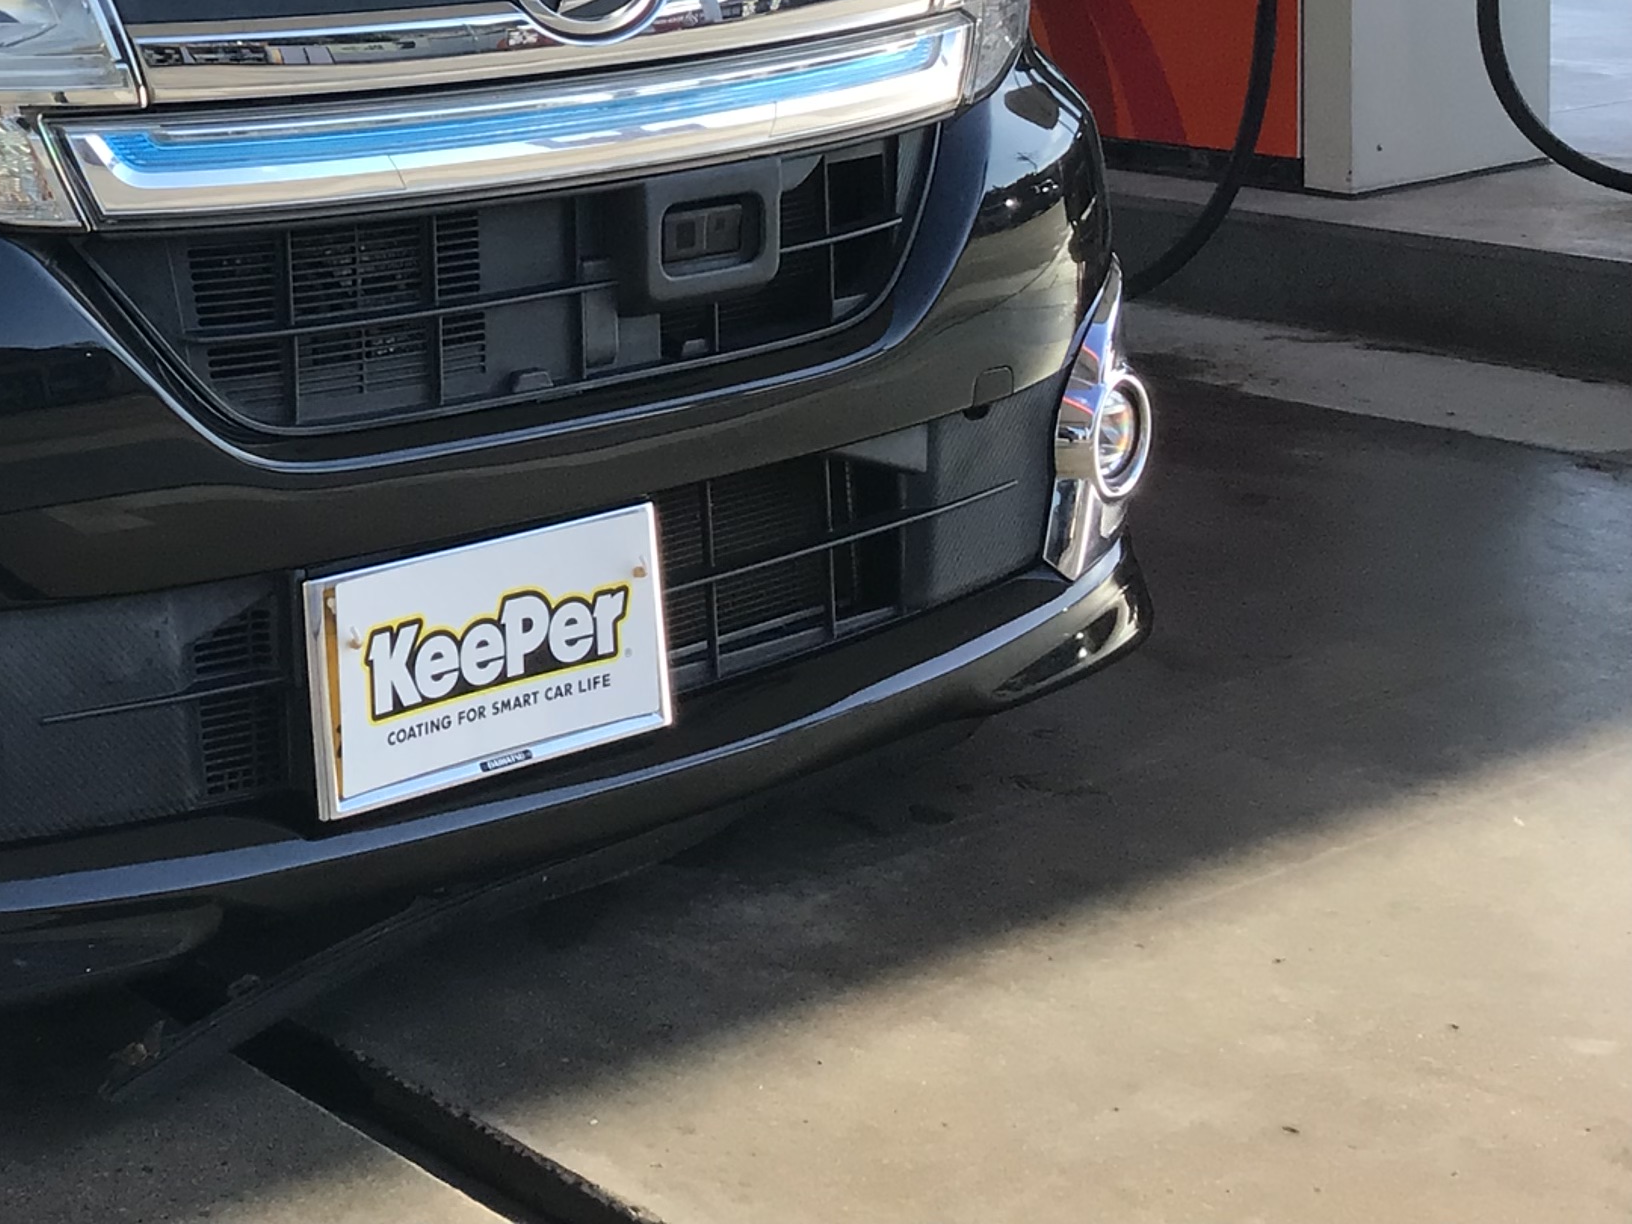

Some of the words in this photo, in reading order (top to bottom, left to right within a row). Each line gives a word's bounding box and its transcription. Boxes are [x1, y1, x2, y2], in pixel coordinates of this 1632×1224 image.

[366, 586, 627, 719] KeePer
[387, 715, 453, 746] COATING
[458, 704, 487, 726] FOR
[491, 690, 540, 715] SMART
[544, 682, 574, 702] CAR
[578, 673, 612, 693] LIFE
